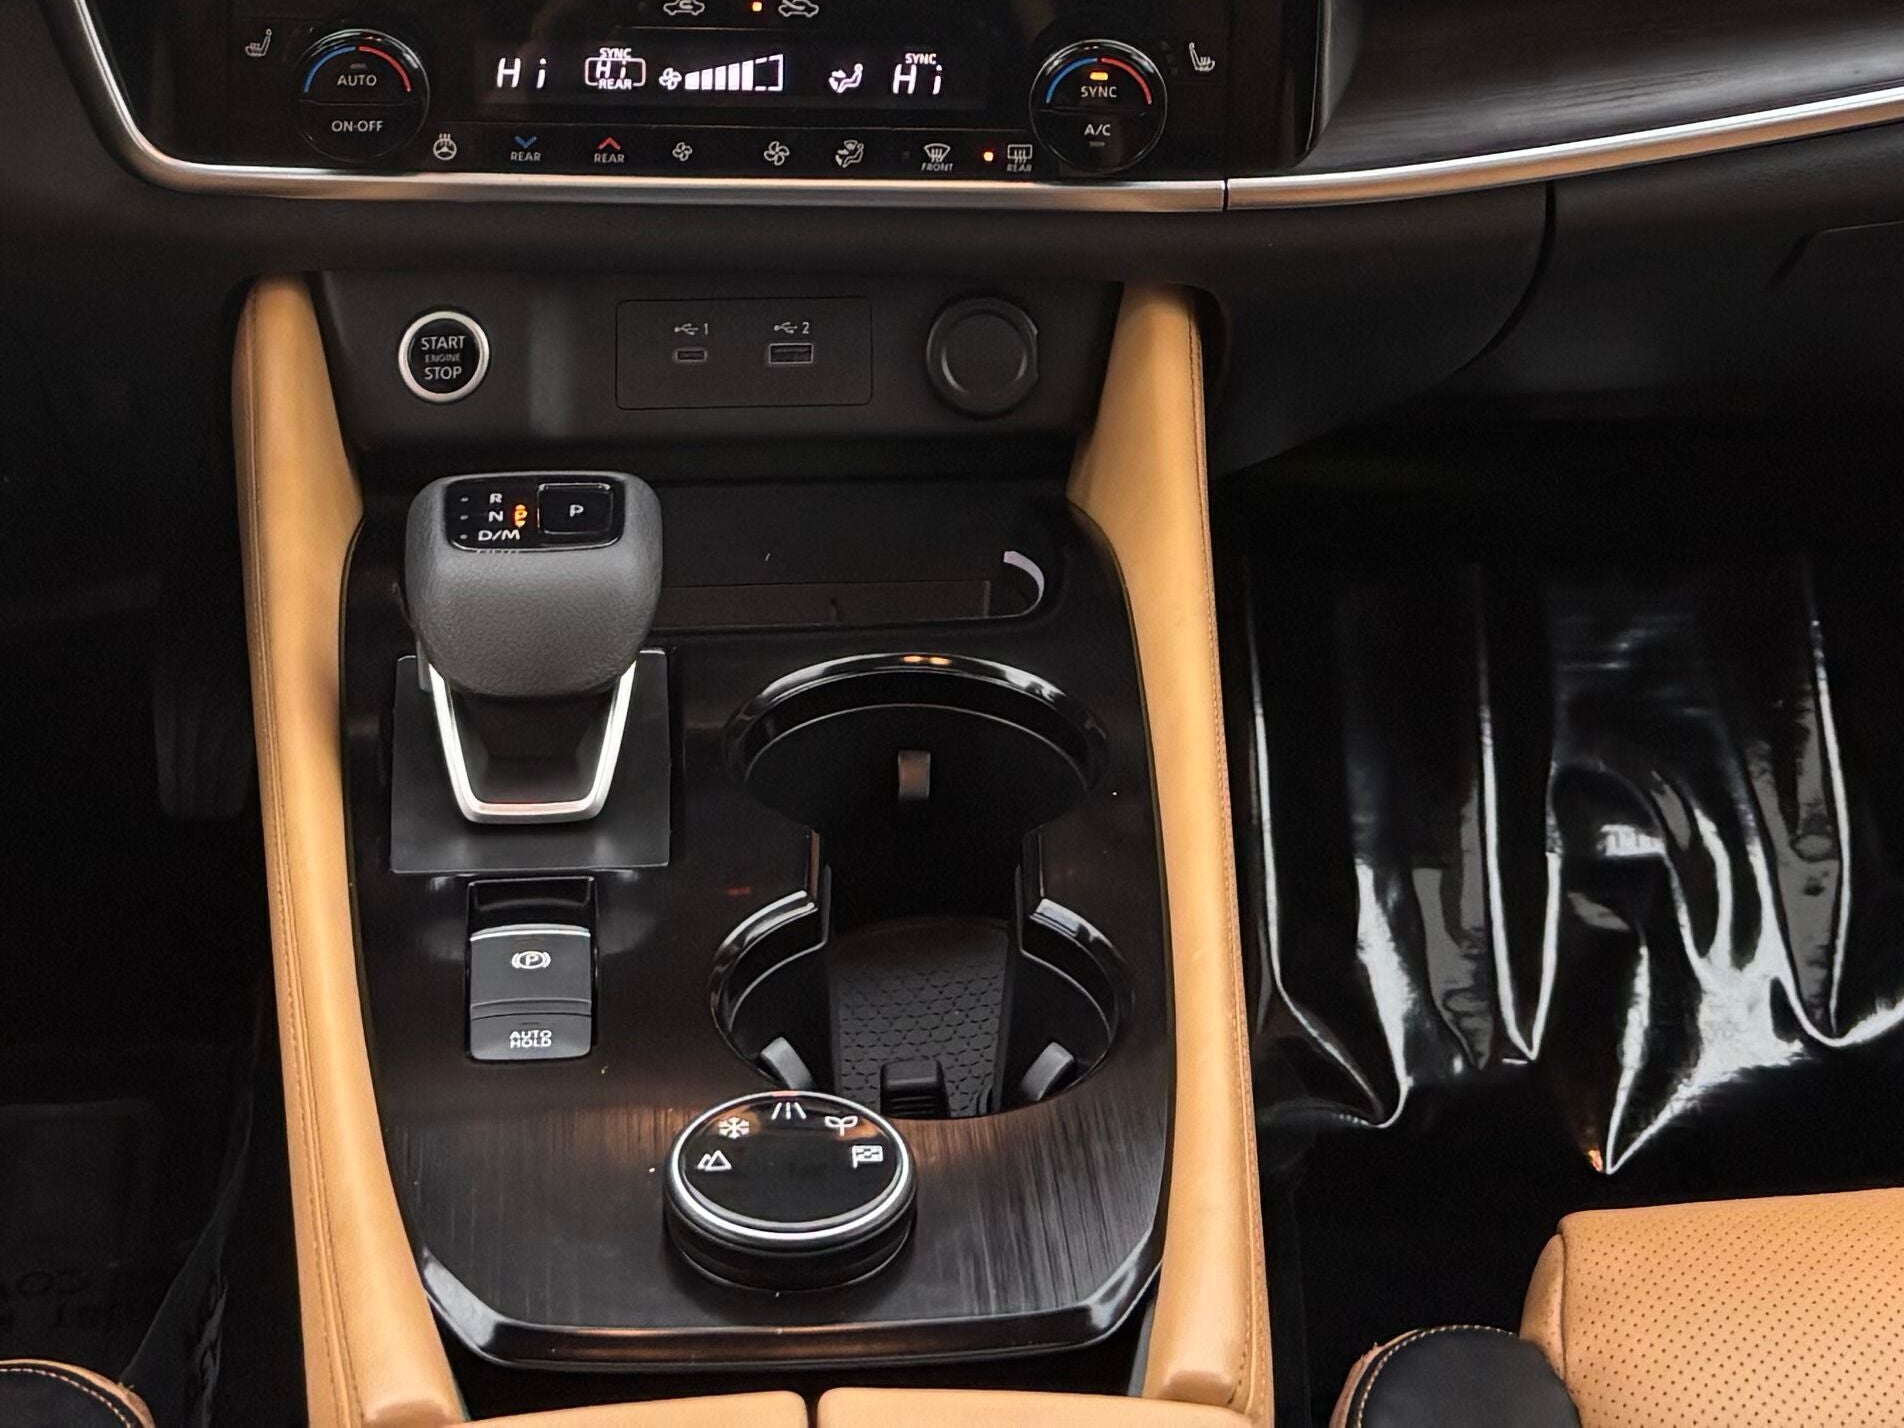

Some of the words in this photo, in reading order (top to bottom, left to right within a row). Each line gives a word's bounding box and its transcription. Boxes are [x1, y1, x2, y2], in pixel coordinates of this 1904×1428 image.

[599, 47, 632, 59] SYNC
[904, 52, 938, 65] SYNC
[337, 74, 377, 87] AUTO
[598, 78, 632, 90] REAR
[1080, 85, 1118, 98] SYNC
[1084, 123, 1111, 136] A/C
[510, 151, 542, 162] REAR
[593, 152, 625, 164] REAR
[921, 162, 954, 172] FRONT
[1006, 163, 1032, 173] REAR
[802, 321, 811, 334] 2
[421, 335, 466, 351] START
[424, 366, 463, 380] STOP
[489, 492, 503, 504] R
[569, 504, 585, 517] P
[488, 511, 505, 523] N
[478, 529, 521, 542] D/M
[509, 1029, 553, 1039] AUTO
[509, 1037, 552, 1049] HOLD
